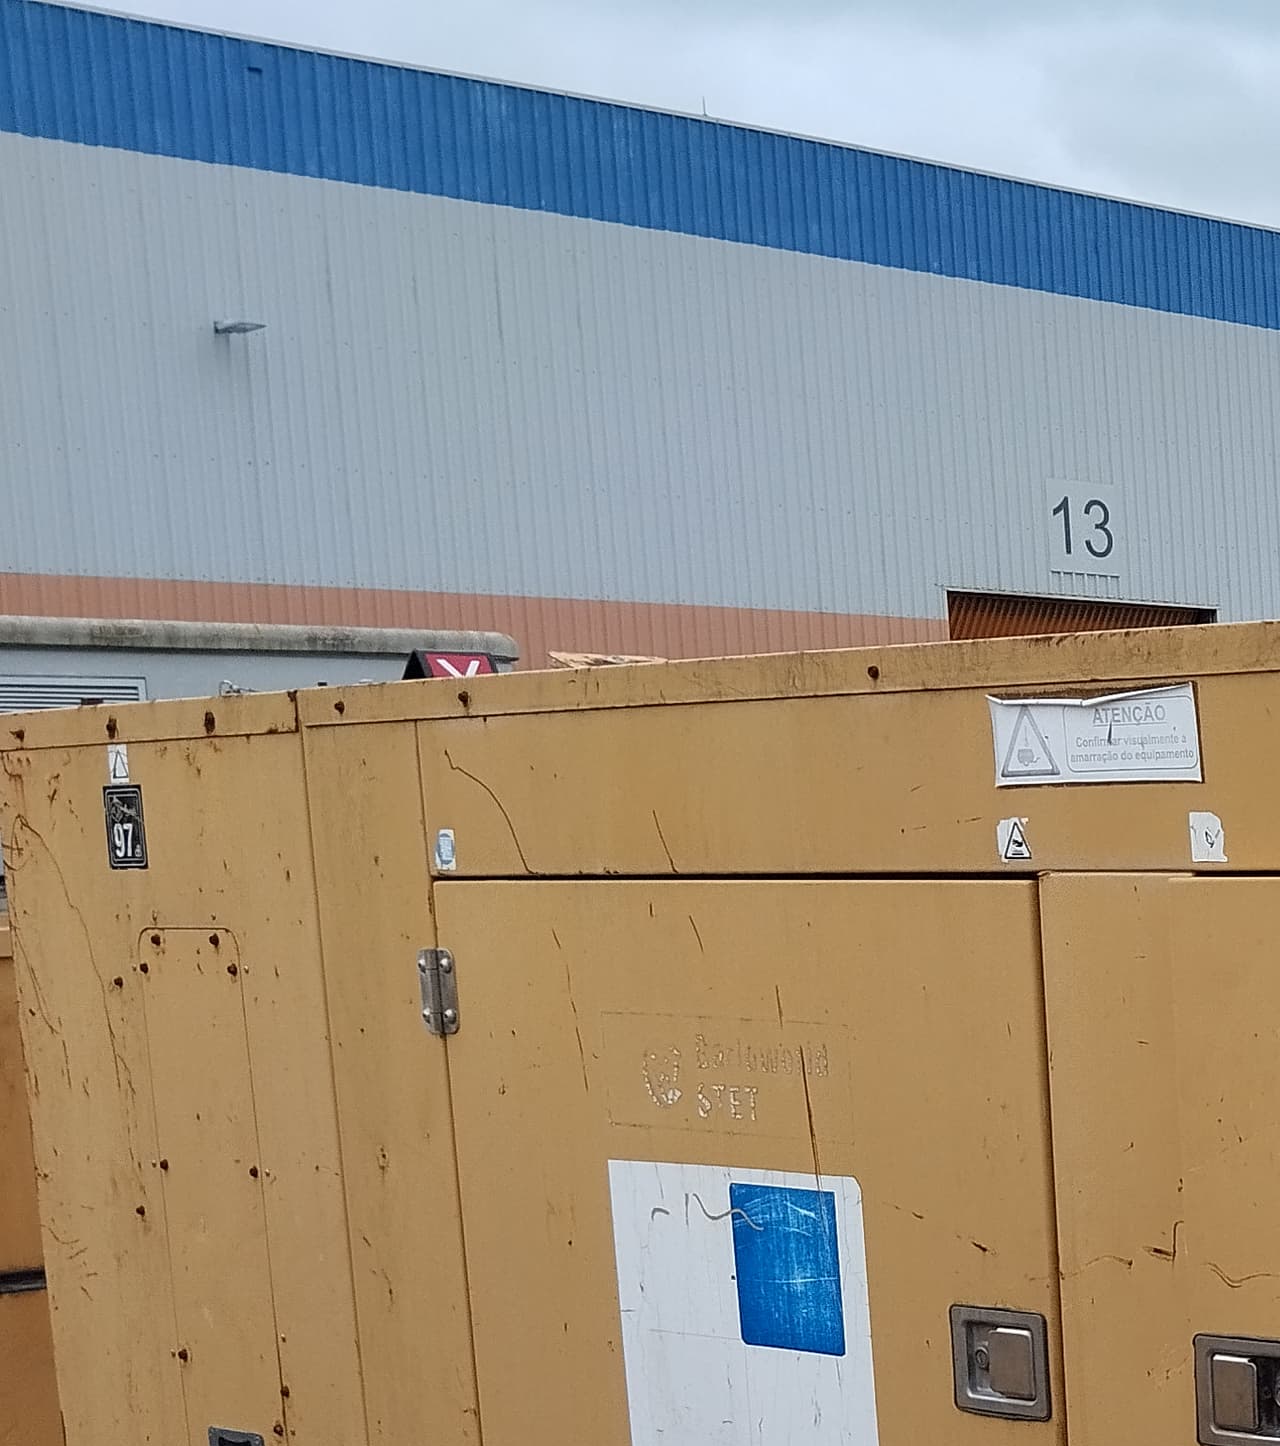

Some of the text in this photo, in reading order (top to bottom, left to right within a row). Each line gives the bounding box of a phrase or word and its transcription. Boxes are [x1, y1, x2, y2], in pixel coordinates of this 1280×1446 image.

[1052, 496, 1114, 558] 13
[1093, 703, 1166, 725] ATENÇÃO
[1070, 749, 1194, 764] amarração do equipamento
[113, 823, 133, 858] 97
